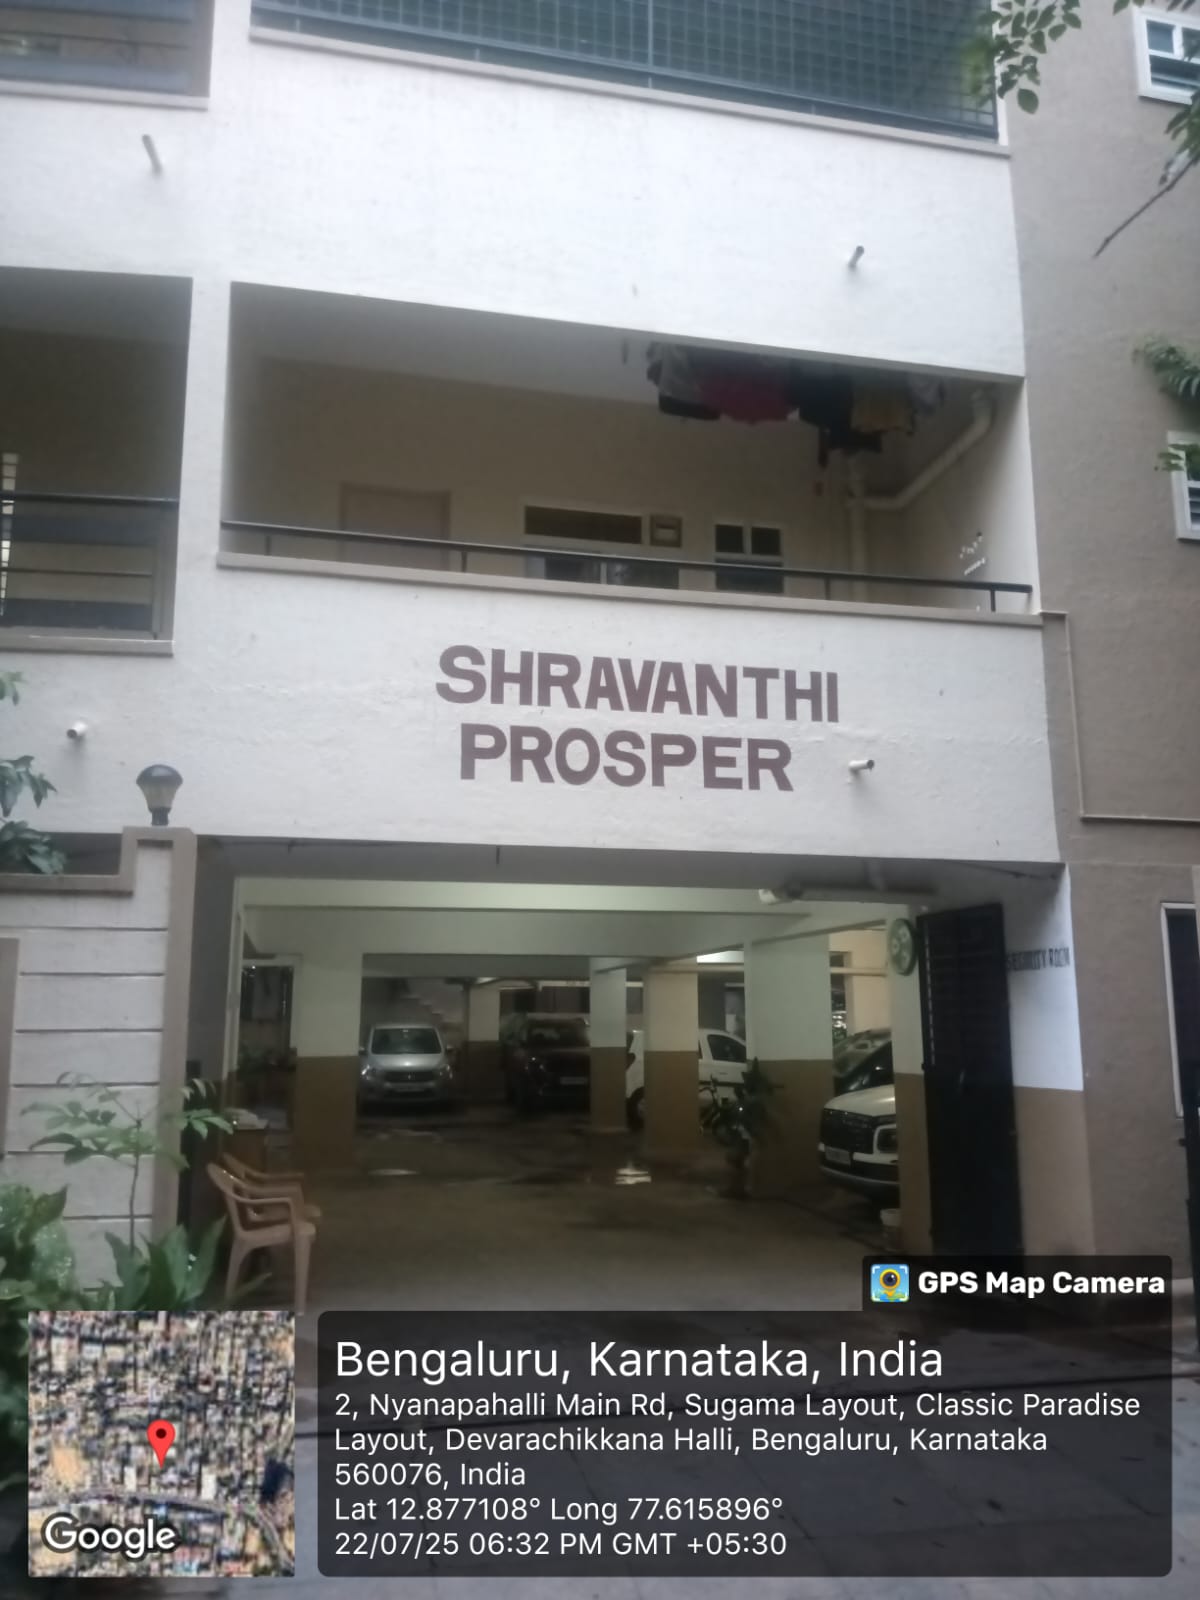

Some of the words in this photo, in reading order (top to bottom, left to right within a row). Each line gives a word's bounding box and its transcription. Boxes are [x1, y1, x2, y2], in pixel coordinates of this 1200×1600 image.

[437, 646, 839, 723] SHRAVANTHI
[461, 723, 794, 792] PROSPER
[1006, 949, 1046, 971] SECITY
